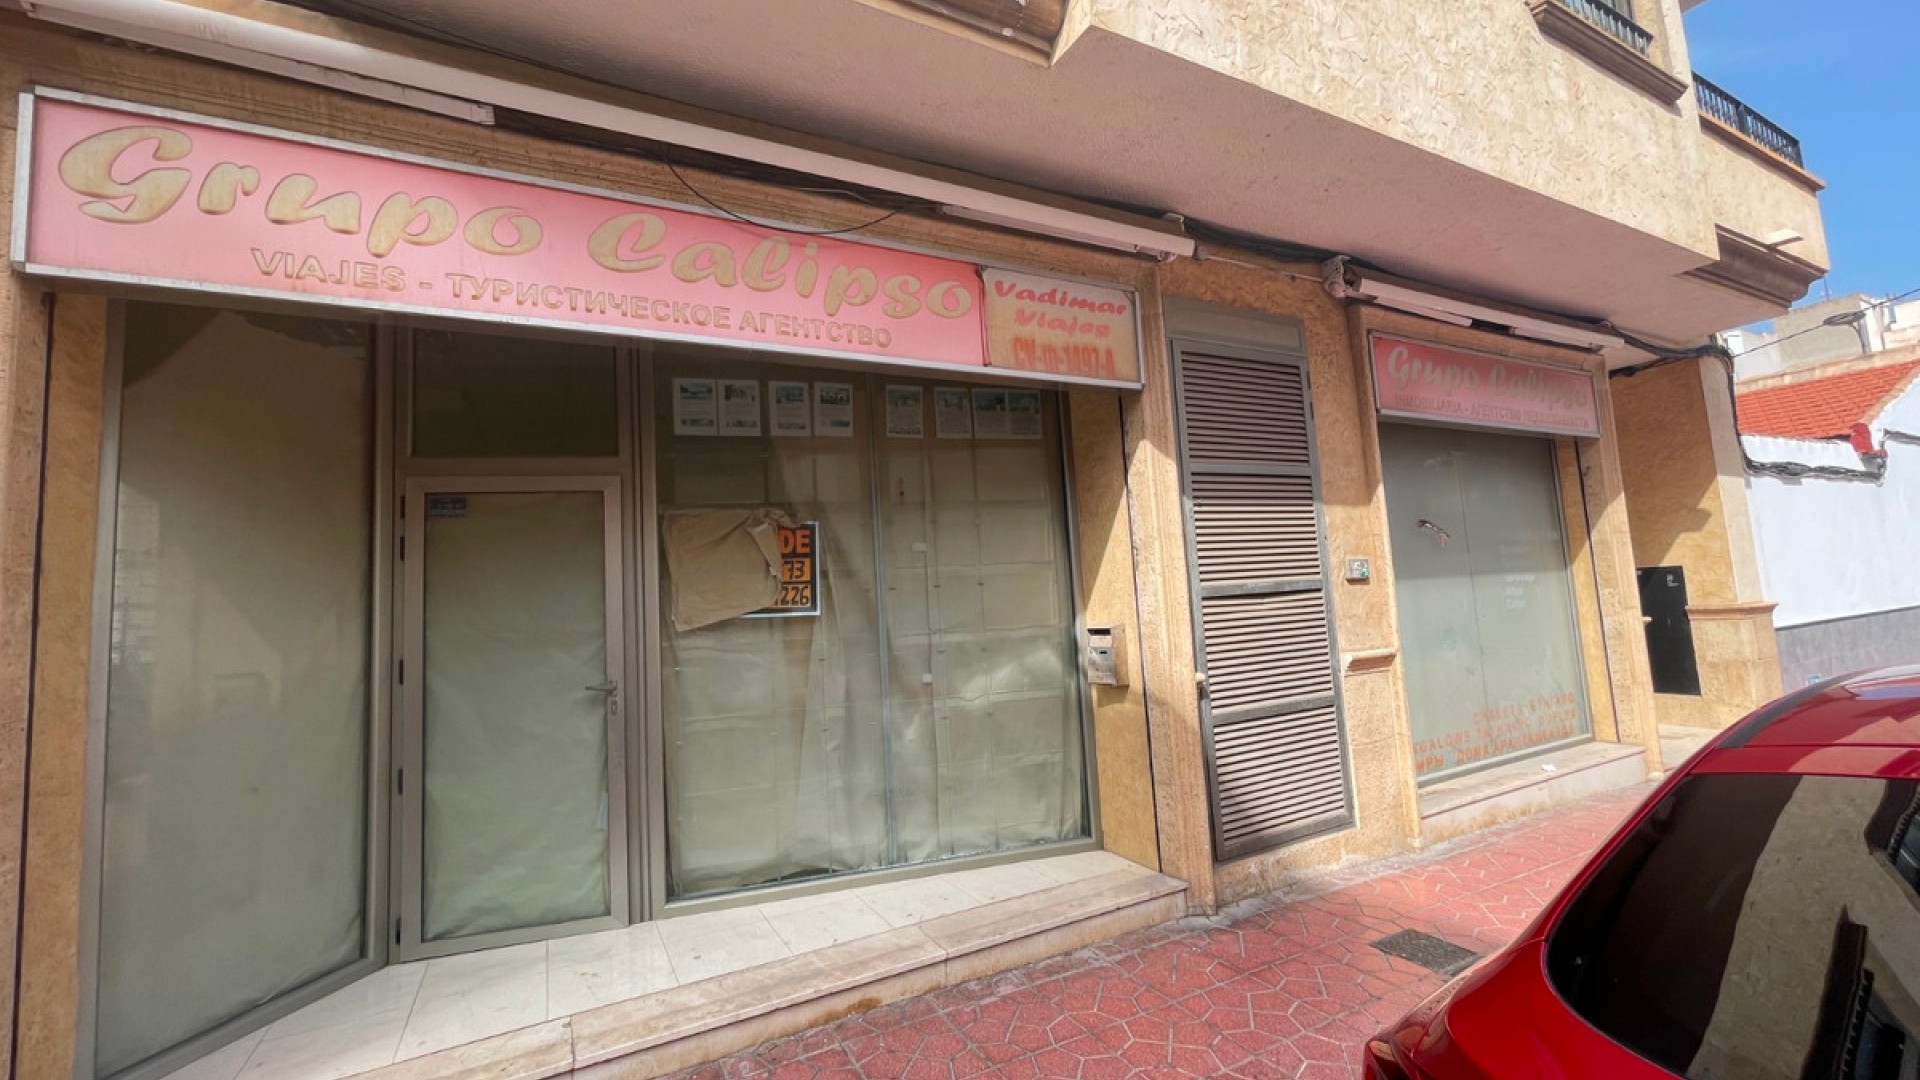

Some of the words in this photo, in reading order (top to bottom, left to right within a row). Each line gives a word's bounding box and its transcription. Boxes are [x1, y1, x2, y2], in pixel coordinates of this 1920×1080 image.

[58, 125, 543, 259] Grupo
[586, 212, 974, 320] Calipso
[250, 247, 406, 292] VIAJES
[446, 271, 731, 329] ТУРИСТИЧЕСКОЕ
[738, 310, 892, 349] АГЕНТСТВО
[993, 279, 1128, 316] Vadimar
[1014, 307, 1111, 338] Viajes
[1387, 346, 1480, 393] Grupo
[1488, 365, 1589, 412] Calipso
